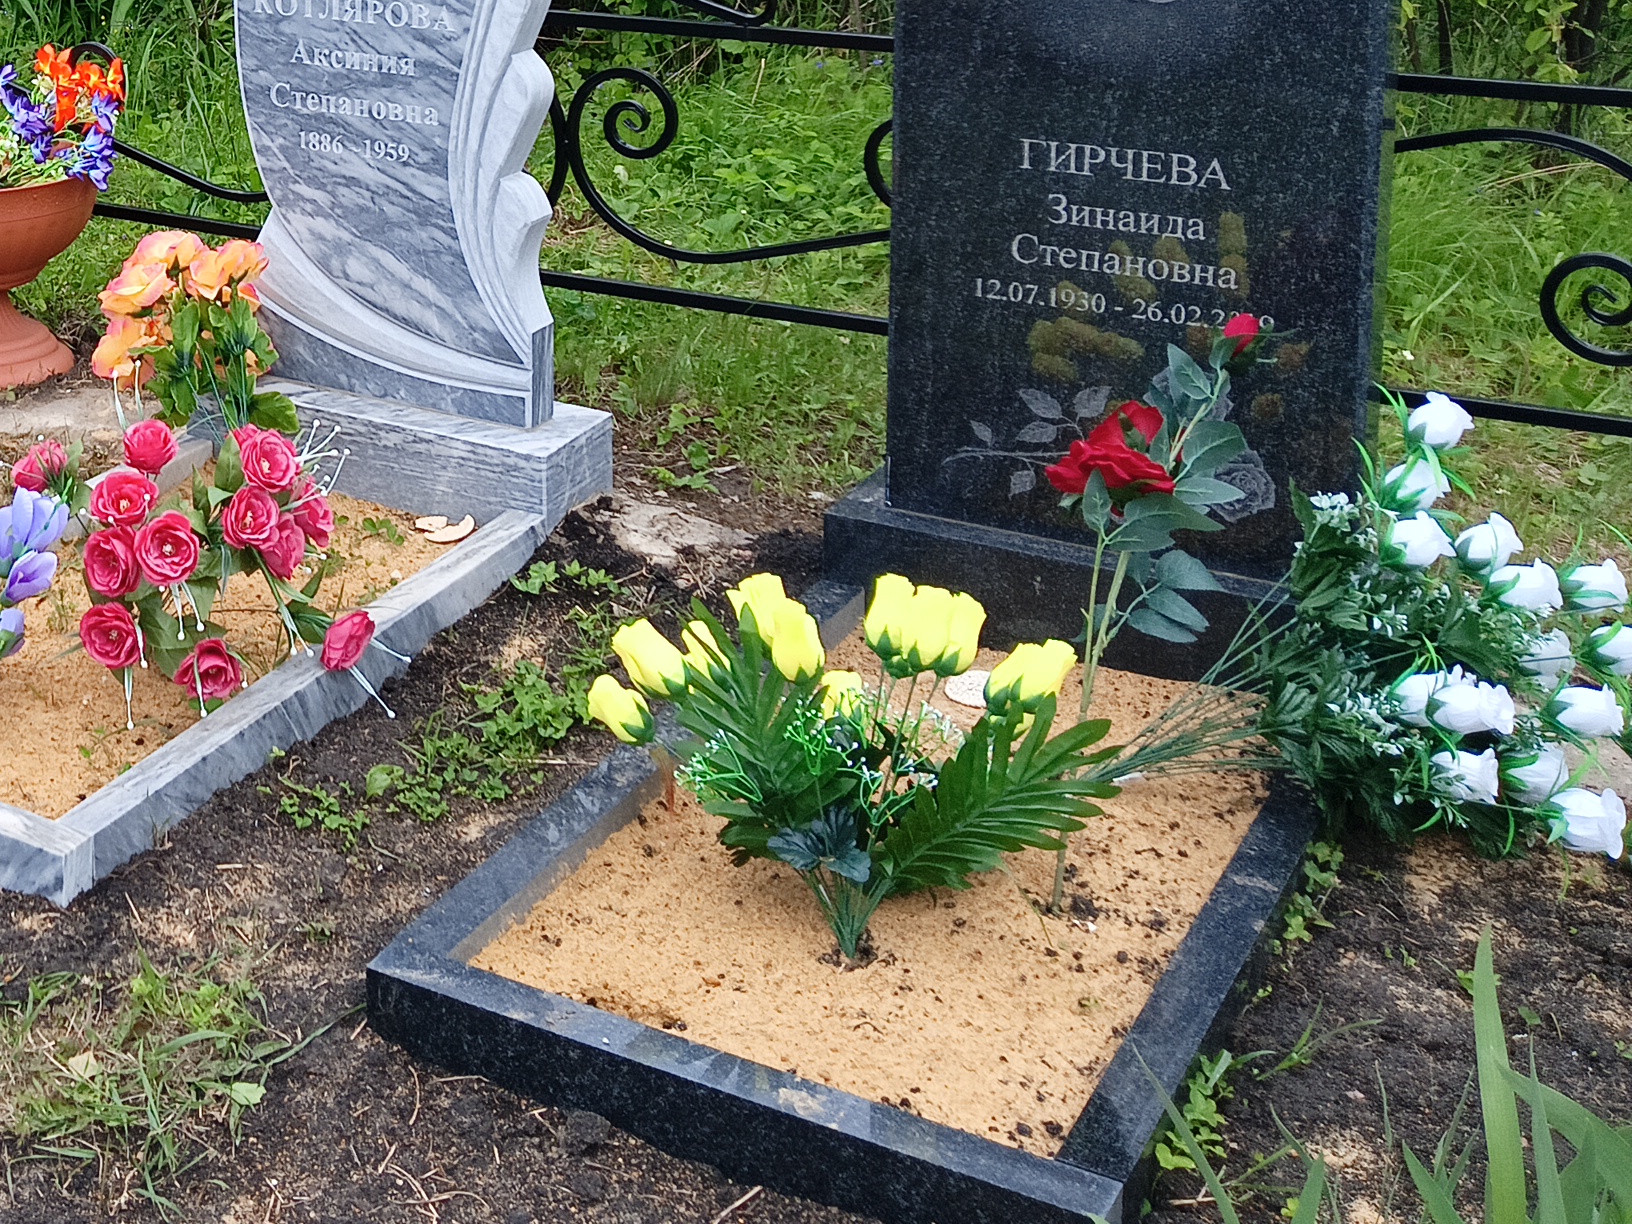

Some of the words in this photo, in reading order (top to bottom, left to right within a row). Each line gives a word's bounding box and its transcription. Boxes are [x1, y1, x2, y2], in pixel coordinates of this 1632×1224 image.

[290, 39, 416, 76] Аксиния
[269, 82, 440, 126] Степановна
[299, 131, 344, 154] 1886
[362, 139, 410, 162] 1959
[1018, 138, 1232, 191] ГИРЧЕВА
[1047, 193, 1207, 241] Зинаида
[1010, 232, 1240, 290] Степановна
[974, 278, 1106, 313] 12.07.1930
[1131, 298, 1275, 329] 26.02.29
